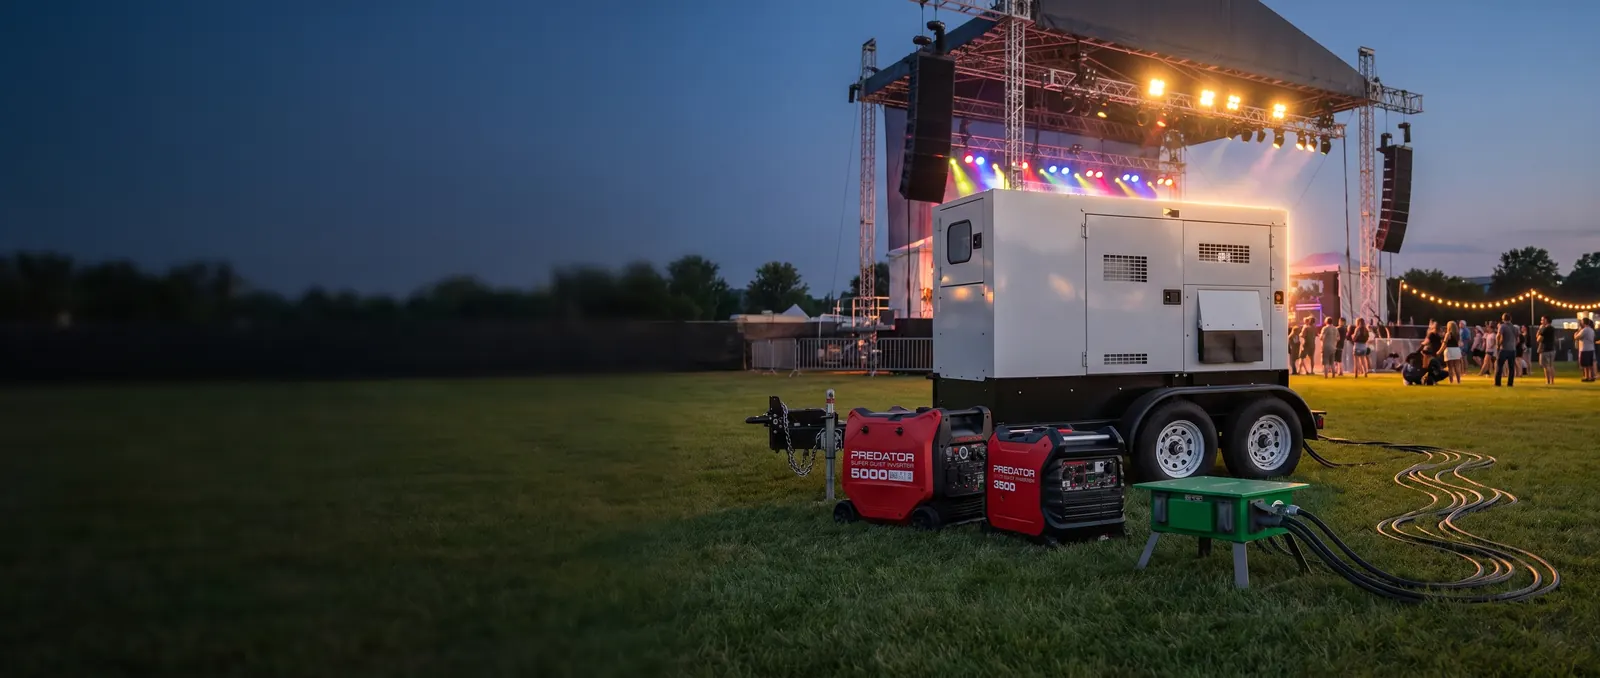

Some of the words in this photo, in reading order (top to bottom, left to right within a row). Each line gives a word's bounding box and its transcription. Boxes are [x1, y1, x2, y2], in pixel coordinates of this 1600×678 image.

[851, 450, 914, 462] PREDATOR
[851, 467, 888, 480] 5000
[993, 464, 1035, 477] PREDATOR
[993, 479, 1016, 492] 3500
